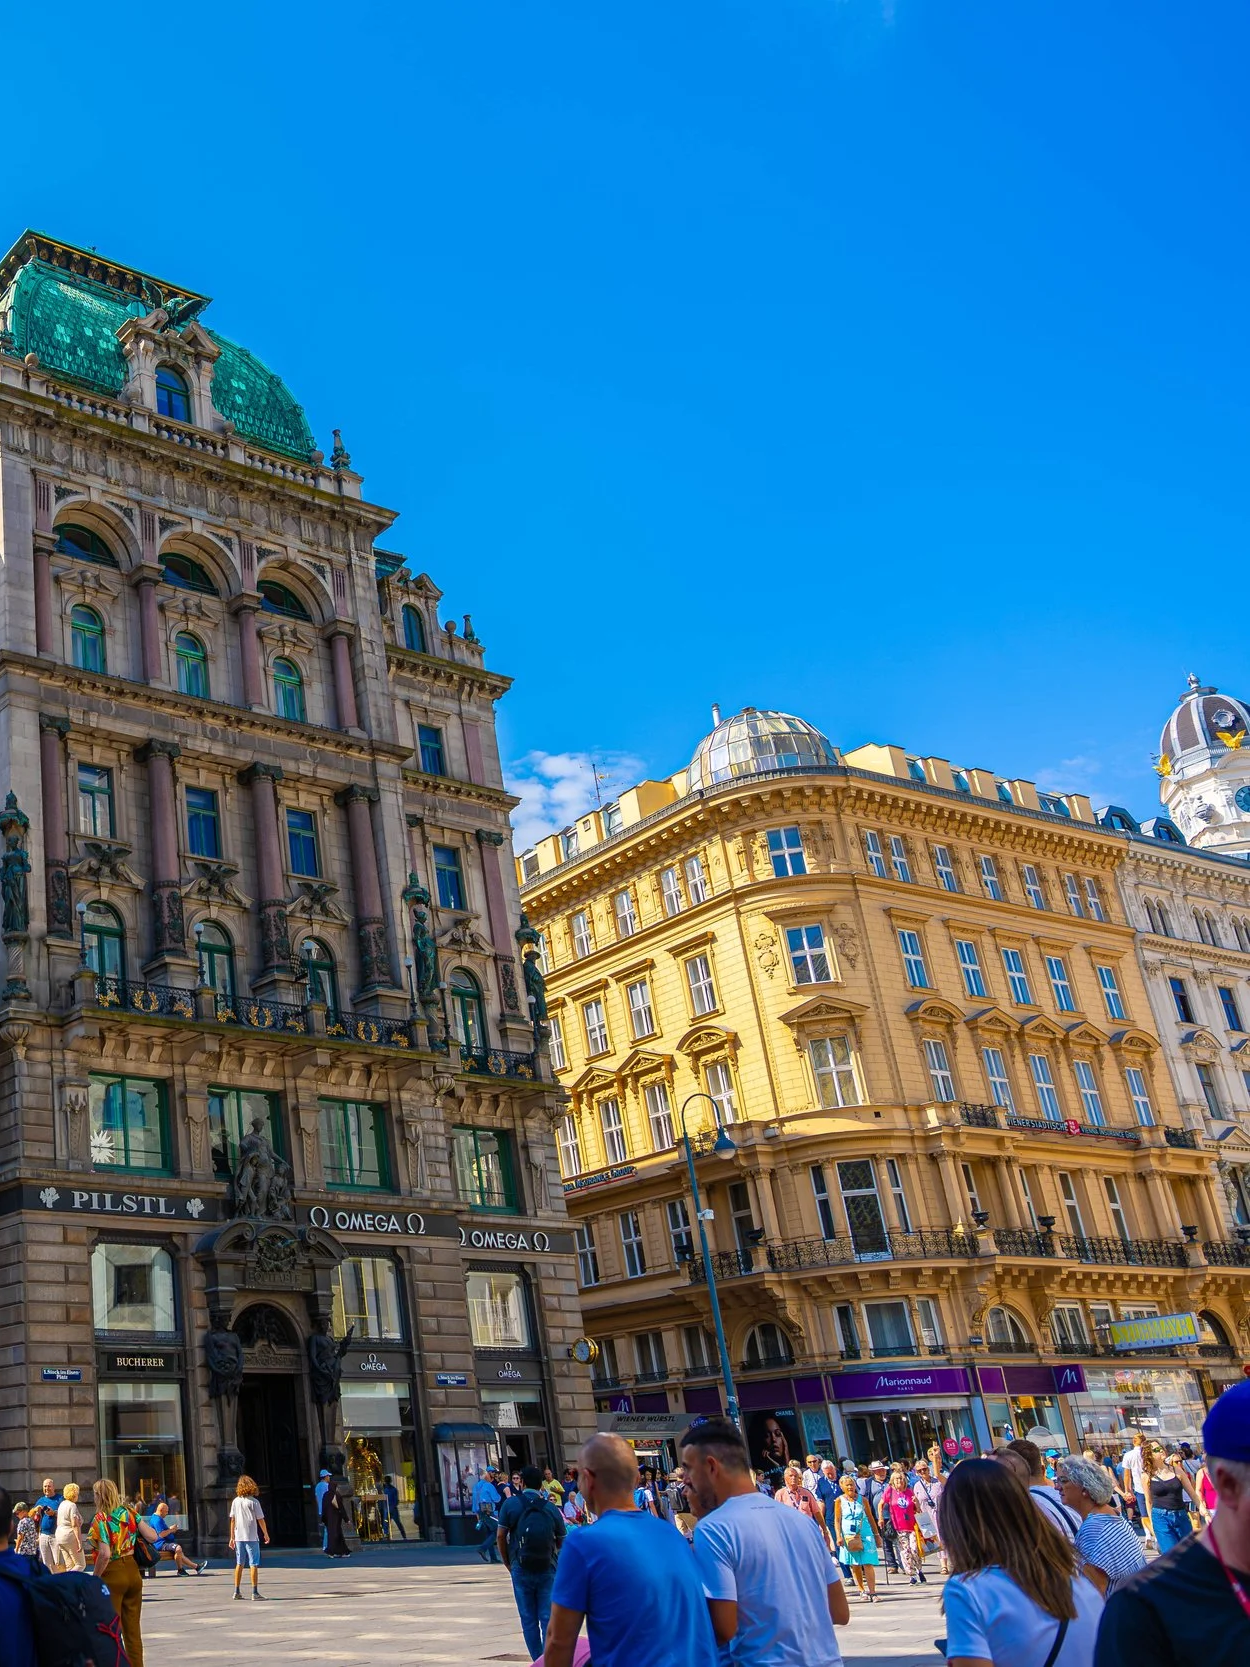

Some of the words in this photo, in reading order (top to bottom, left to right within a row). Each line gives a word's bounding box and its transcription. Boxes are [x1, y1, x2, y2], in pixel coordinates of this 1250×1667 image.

[71, 1190, 176, 1215] PILSTL
[335, 1211, 401, 1233] OMEGA
[471, 1230, 530, 1250] OMEGA
[116, 1357, 165, 1367] BUCHERER
[361, 1362, 387, 1371] OMEGA
[498, 1370, 522, 1378] OMEGA
[875, 1375, 932, 1389] Marionnaud
[646, 1414, 676, 1422] WÜRSTL
